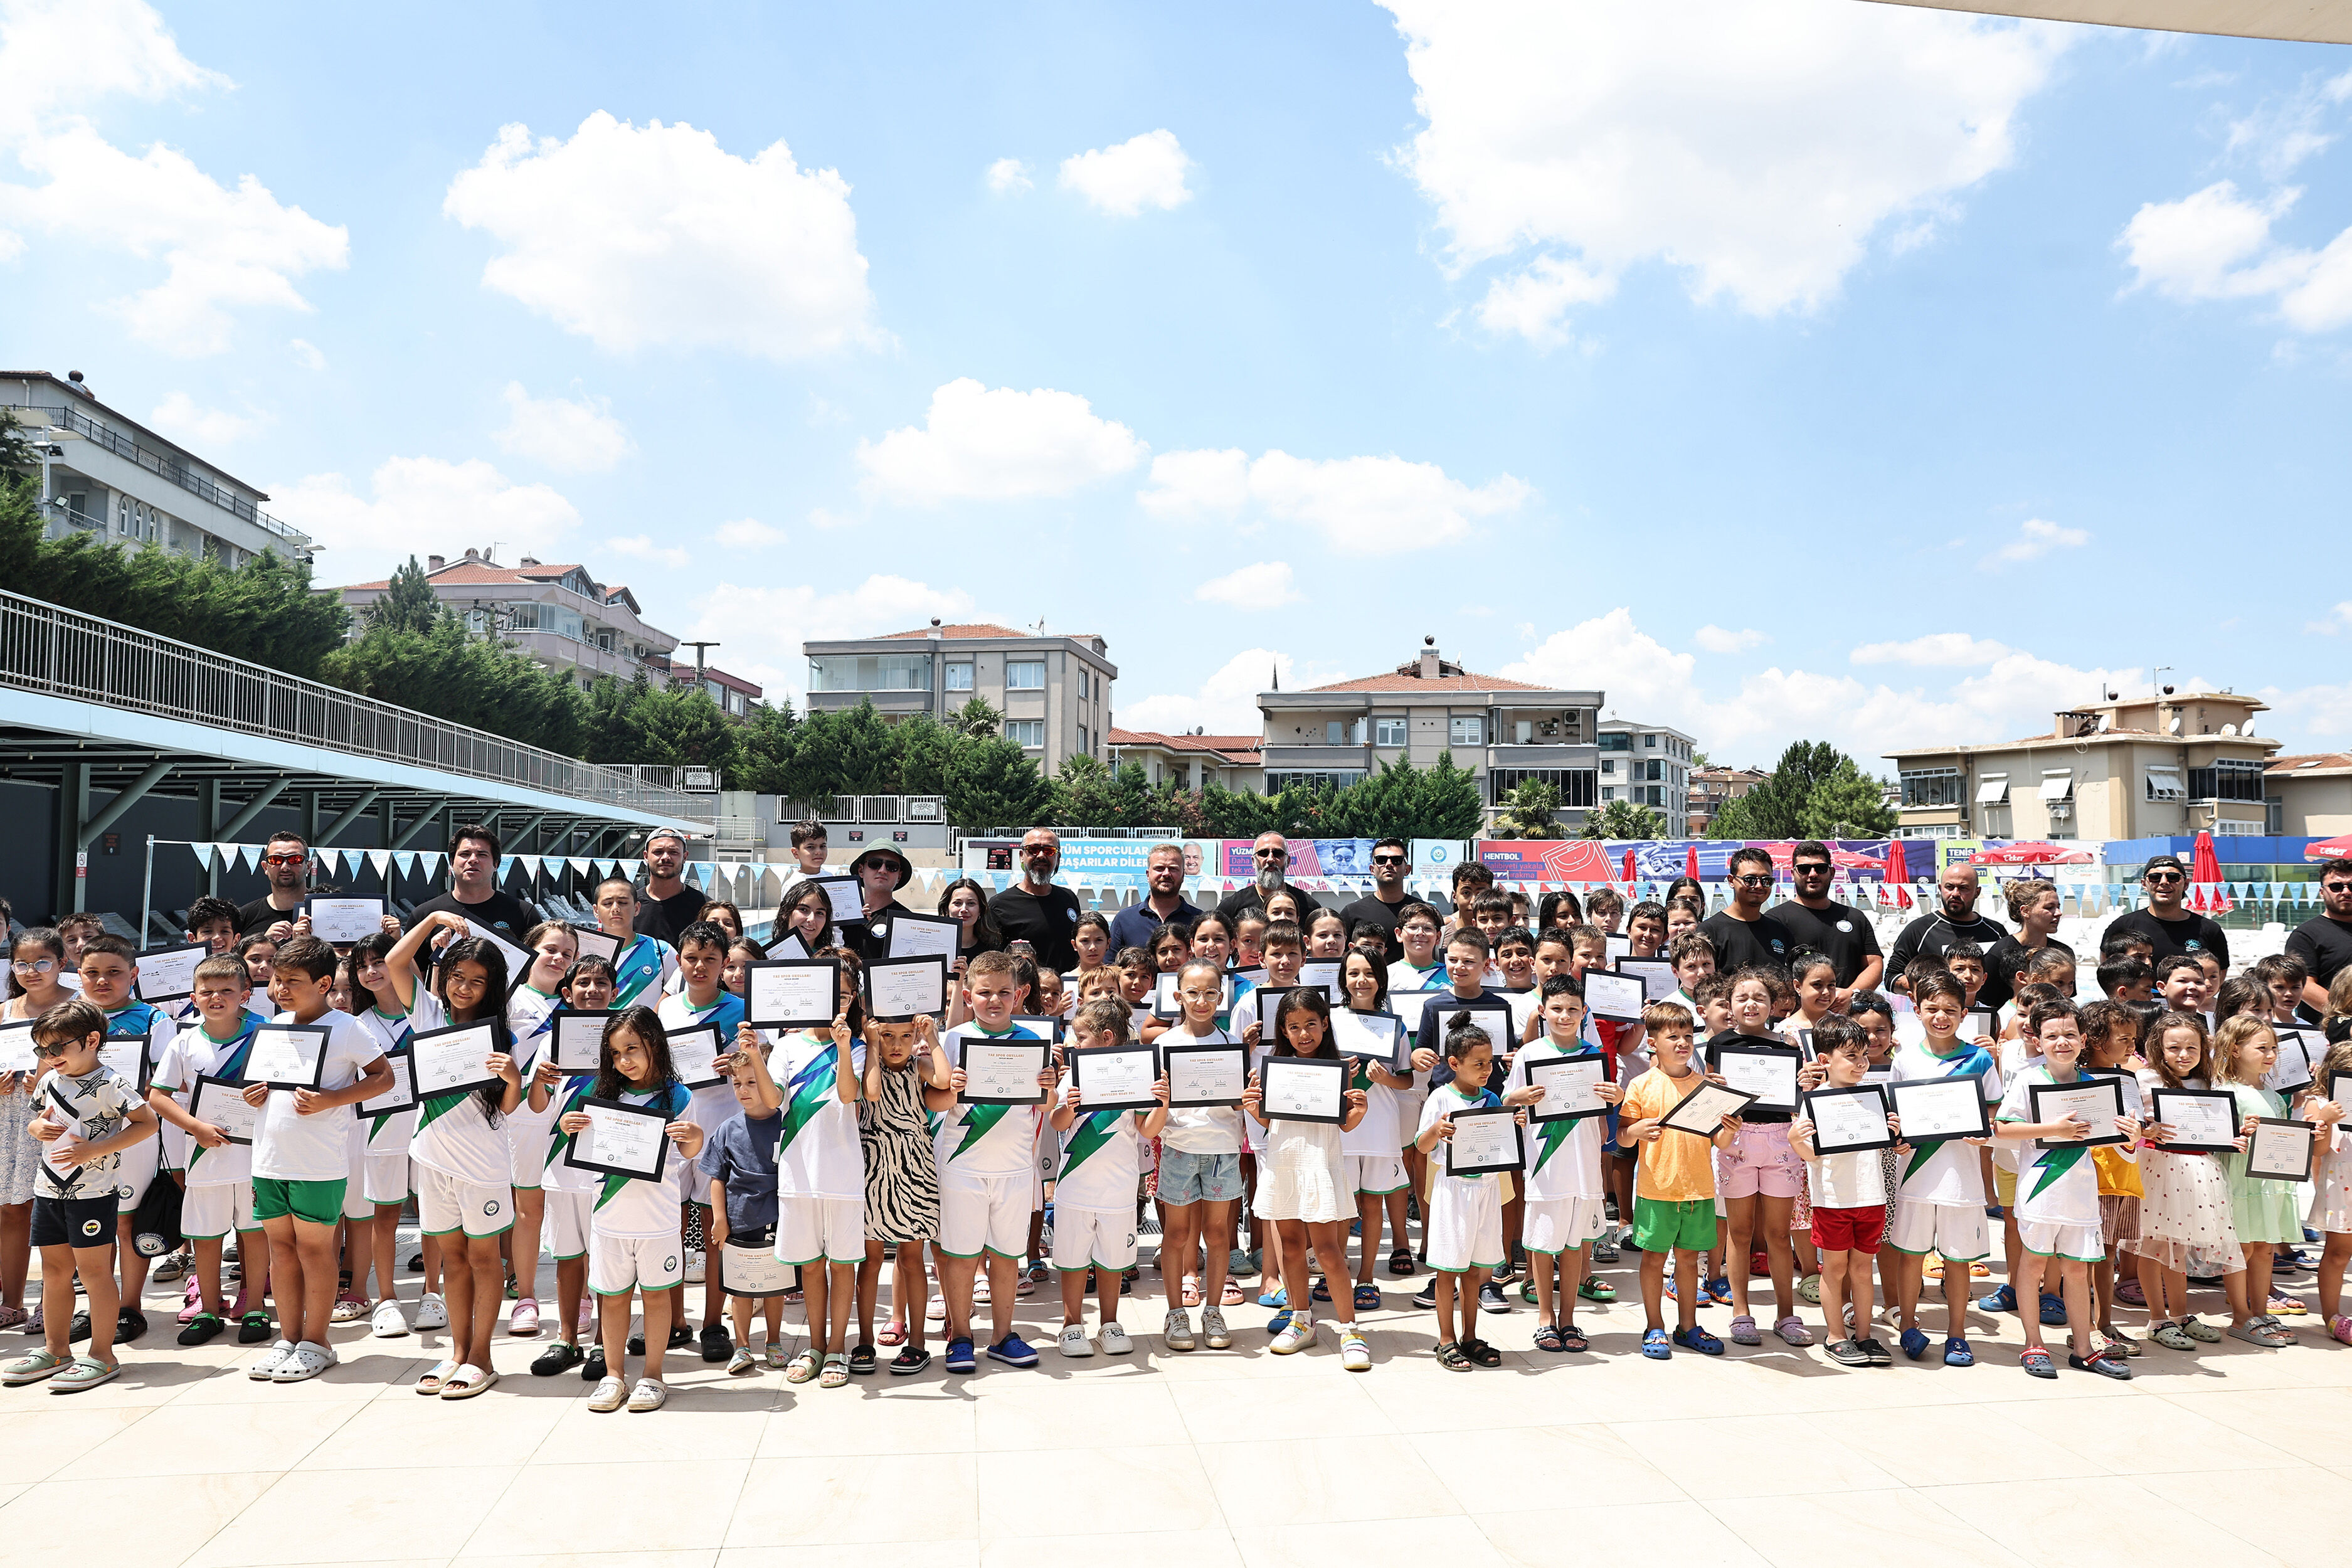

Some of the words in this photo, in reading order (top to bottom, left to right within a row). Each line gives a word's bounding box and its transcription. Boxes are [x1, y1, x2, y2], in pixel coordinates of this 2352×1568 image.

[1060, 844, 1081, 855] TÜM
[1084, 846, 1149, 855] SPORCULAR
[1949, 848, 1973, 856] TENİS
[1060, 857, 1118, 869] BAŞARILAR
[1120, 856, 1148, 867] DİLER
[1244, 867, 1254, 875] yol
